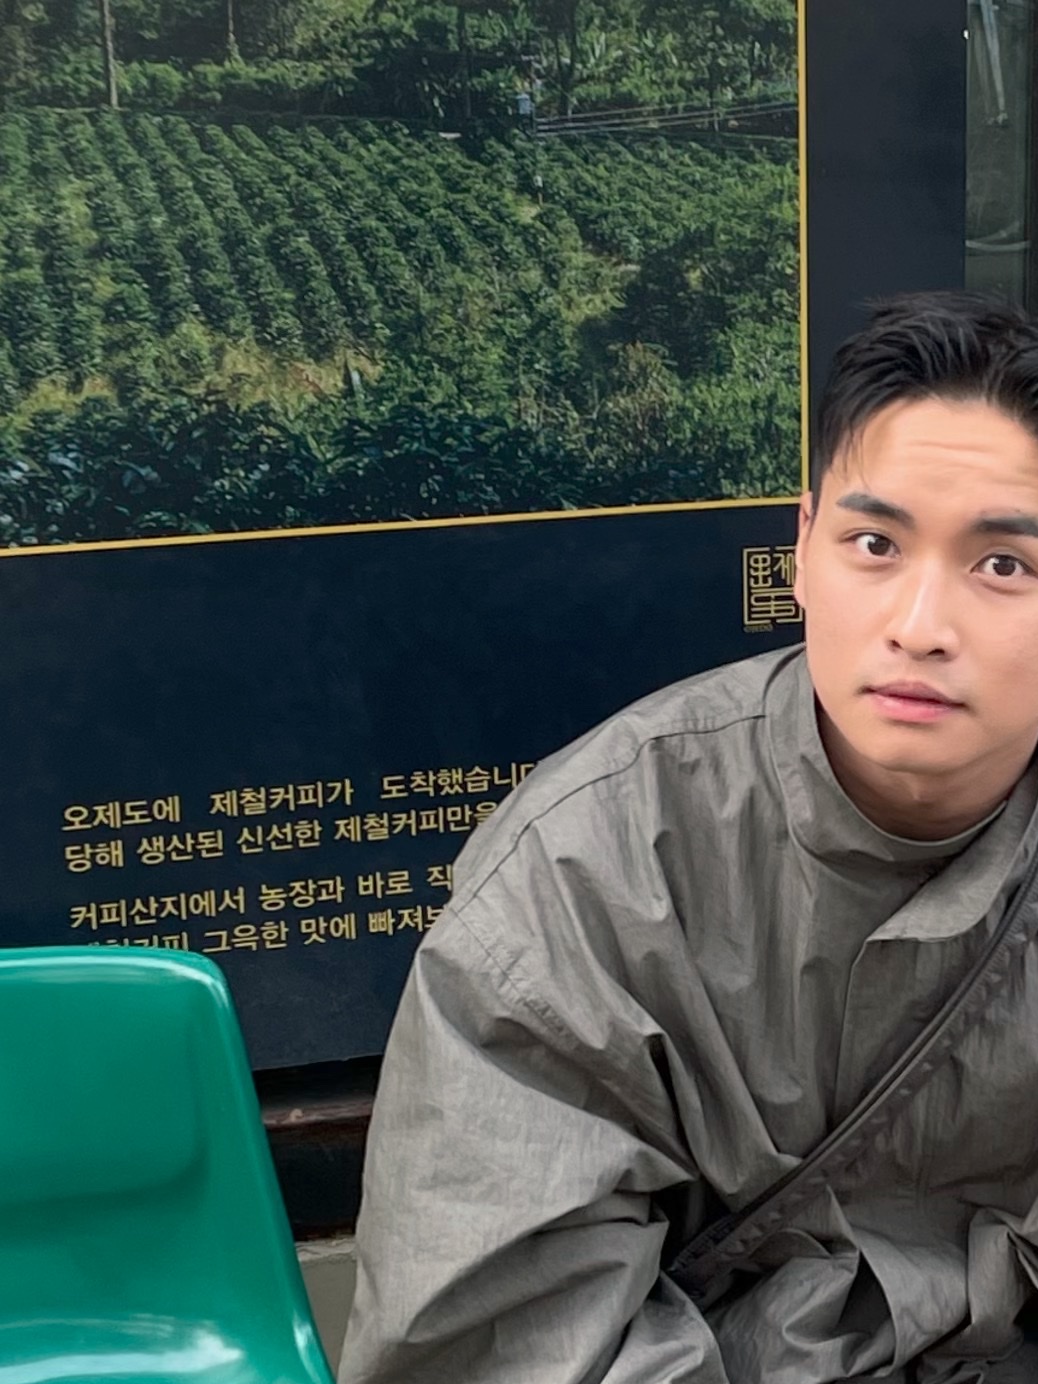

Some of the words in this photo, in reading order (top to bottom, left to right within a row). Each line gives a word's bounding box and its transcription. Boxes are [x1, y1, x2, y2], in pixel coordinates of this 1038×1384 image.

[61, 795, 181, 831] 오제도에
[209, 778, 354, 817] 제철커피가
[64, 839, 124, 872] 당해
[136, 829, 224, 865] 생산된
[236, 819, 323, 854] 신선한
[69, 886, 245, 930] 커피산지에서
[258, 876, 345, 911] 농장과
[357, 870, 413, 899] 바로
[202, 920, 289, 953] 그윽한
[300, 912, 356, 945] 맛에
